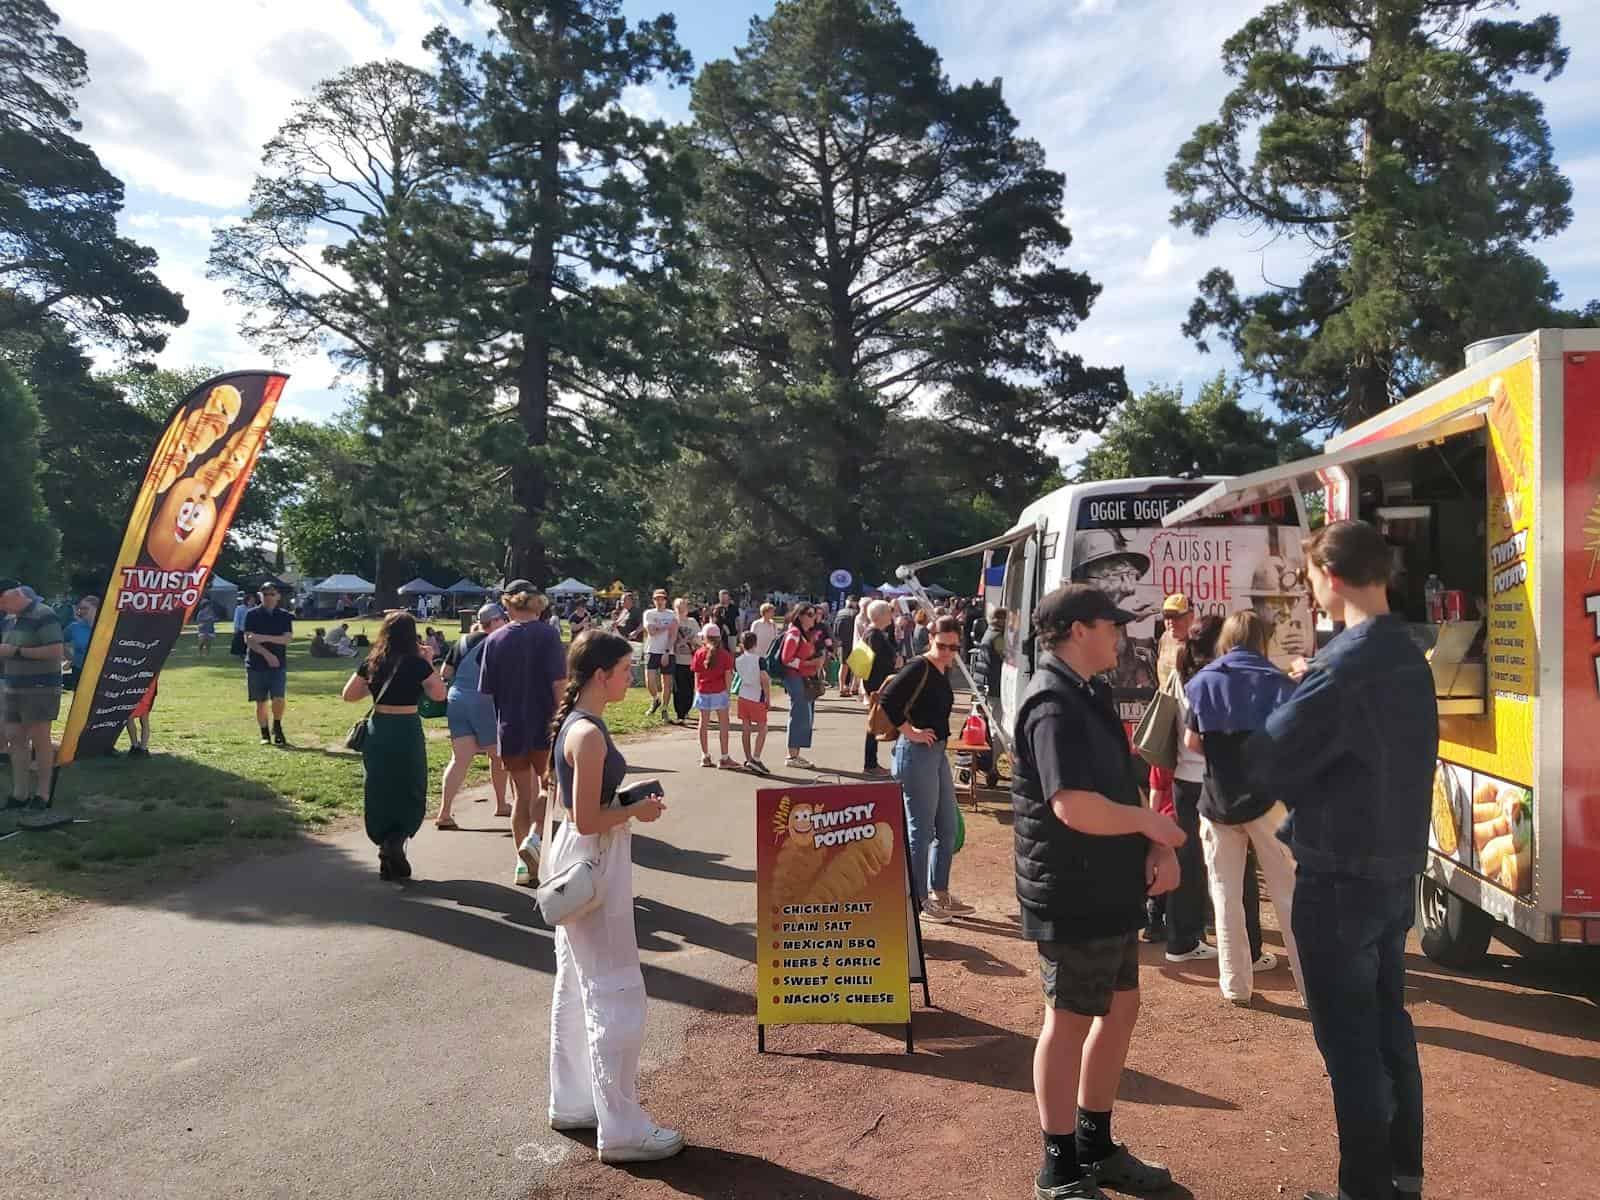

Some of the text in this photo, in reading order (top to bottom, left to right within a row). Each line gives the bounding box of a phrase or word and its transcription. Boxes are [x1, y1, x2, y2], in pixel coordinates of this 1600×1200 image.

[1090, 501, 1127, 521] OGGIE
[1163, 540, 1232, 561] AUSSIE
[1491, 530, 1528, 568] TWISTY
[122, 567, 208, 590] TWISTY
[1162, 565, 1232, 601] OGGIE
[1494, 561, 1528, 593] POTATO
[118, 589, 199, 611] POTATO
[810, 802, 876, 830] TWISTY
[814, 823, 876, 849] POTATO
[783, 902, 873, 915] CHICKEN SALT
[783, 920, 852, 932] PLAIN SALT
[783, 938, 876, 950] MEXICAN BBQ
[783, 955, 881, 968] HERB & GARLIC
[783, 975, 873, 986] SWEET CHILLI
[783, 992, 895, 1004] NACHO'S CHEESE
